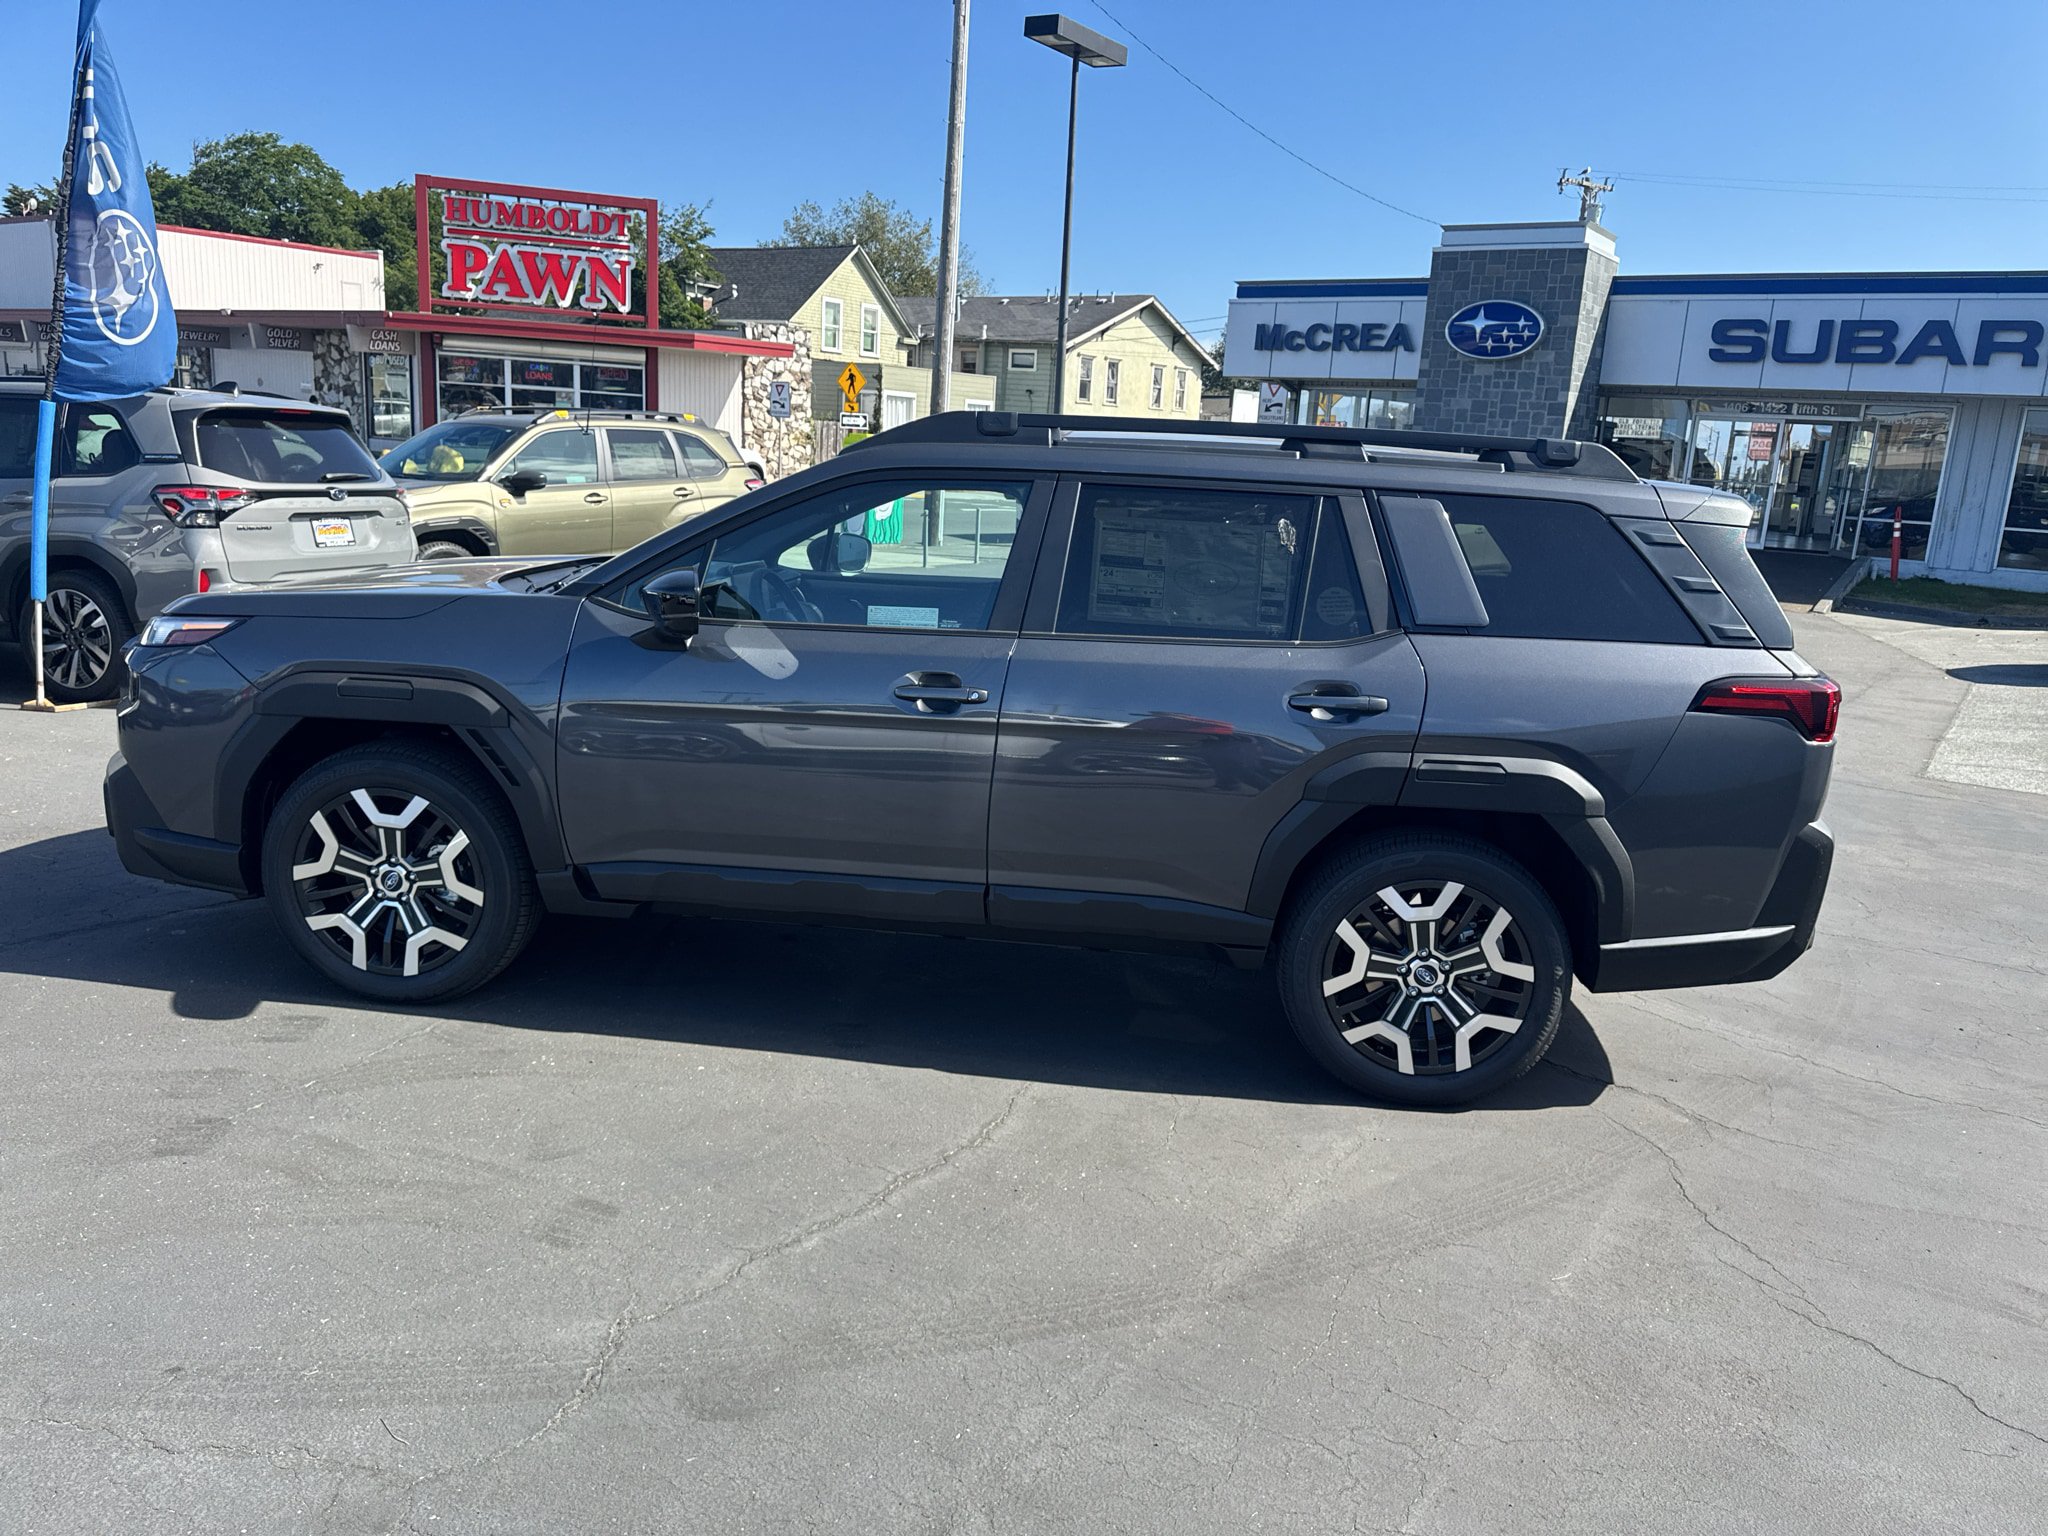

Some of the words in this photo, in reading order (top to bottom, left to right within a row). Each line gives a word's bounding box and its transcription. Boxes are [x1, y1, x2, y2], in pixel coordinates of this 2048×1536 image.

[443, 195, 633, 238] HUMBOLDT
[445, 242, 633, 307] PAWN
[178, 330, 222, 342] JEWELRY
[266, 327, 293, 339] GOLD
[371, 329, 398, 341] CASH
[1253, 321, 1417, 353] McCREA
[268, 337, 301, 349] SILVER
[369, 340, 401, 352] LOANS
[1708, 318, 2045, 367] SUBAR
[525, 371, 553, 380] LOANS
[1822, 404, 1838, 416] St.
